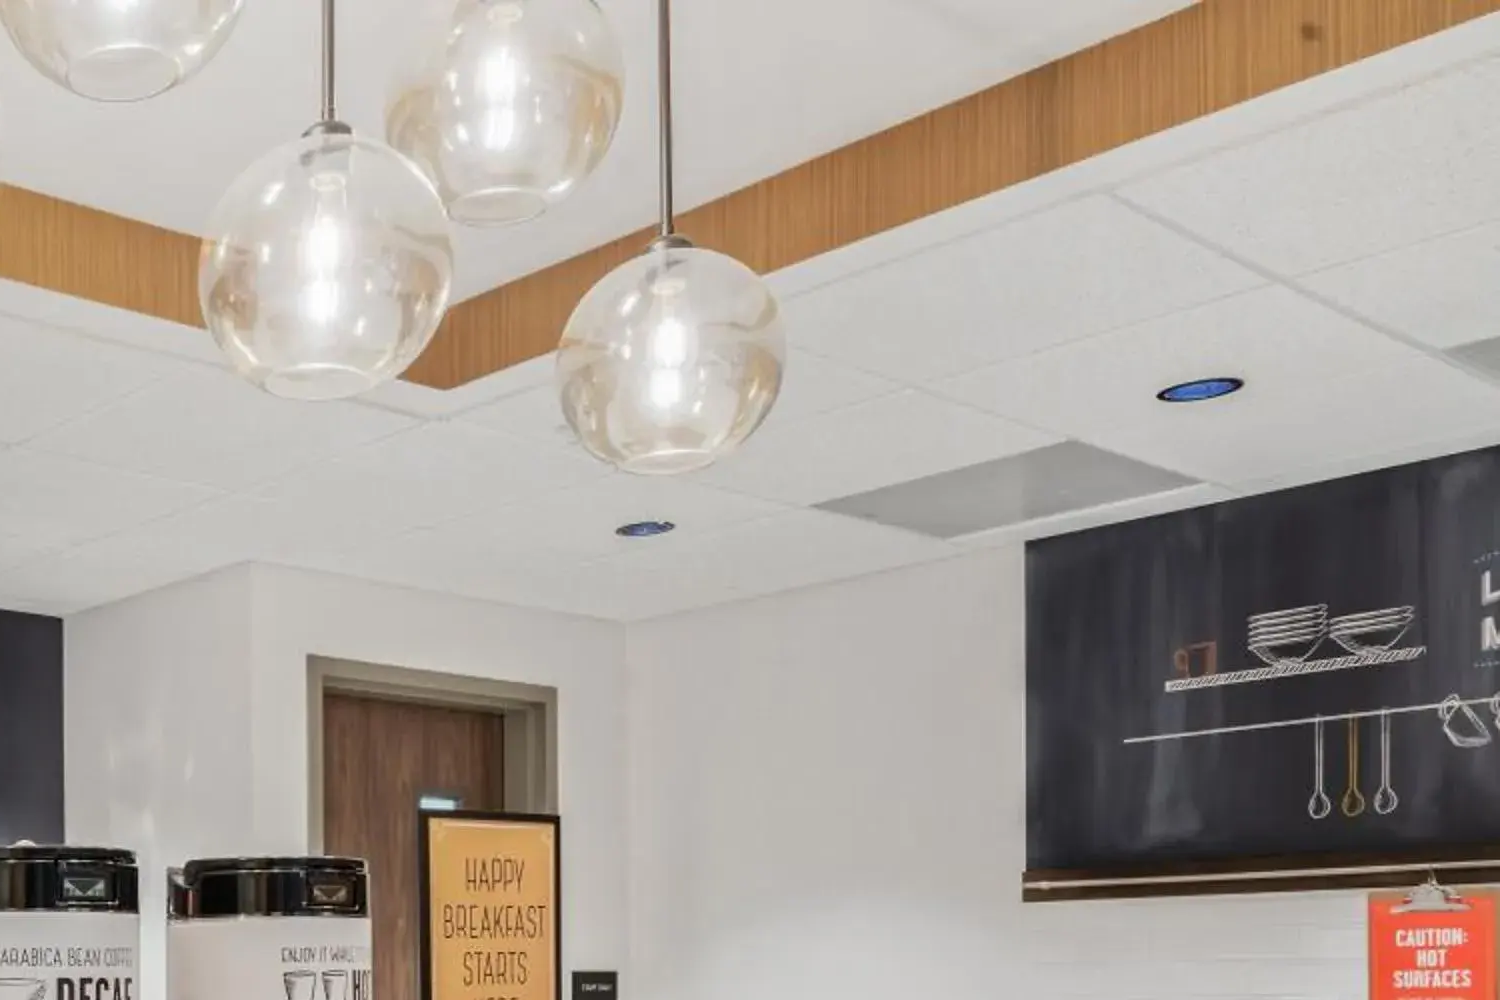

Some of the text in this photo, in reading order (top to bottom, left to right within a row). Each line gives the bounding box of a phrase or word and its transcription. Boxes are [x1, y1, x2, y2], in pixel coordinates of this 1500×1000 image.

[466, 857, 525, 893] HAPPY
[443, 903, 546, 939] BREAKFAST
[1395, 928, 1469, 948] CAUTION:
[0, 947, 63, 967] ARABICA
[67, 947, 100, 967] BEAN
[1416, 949, 1447, 968] HOT
[463, 951, 528, 986] STARTS
[1393, 969, 1472, 989] SURFACES
